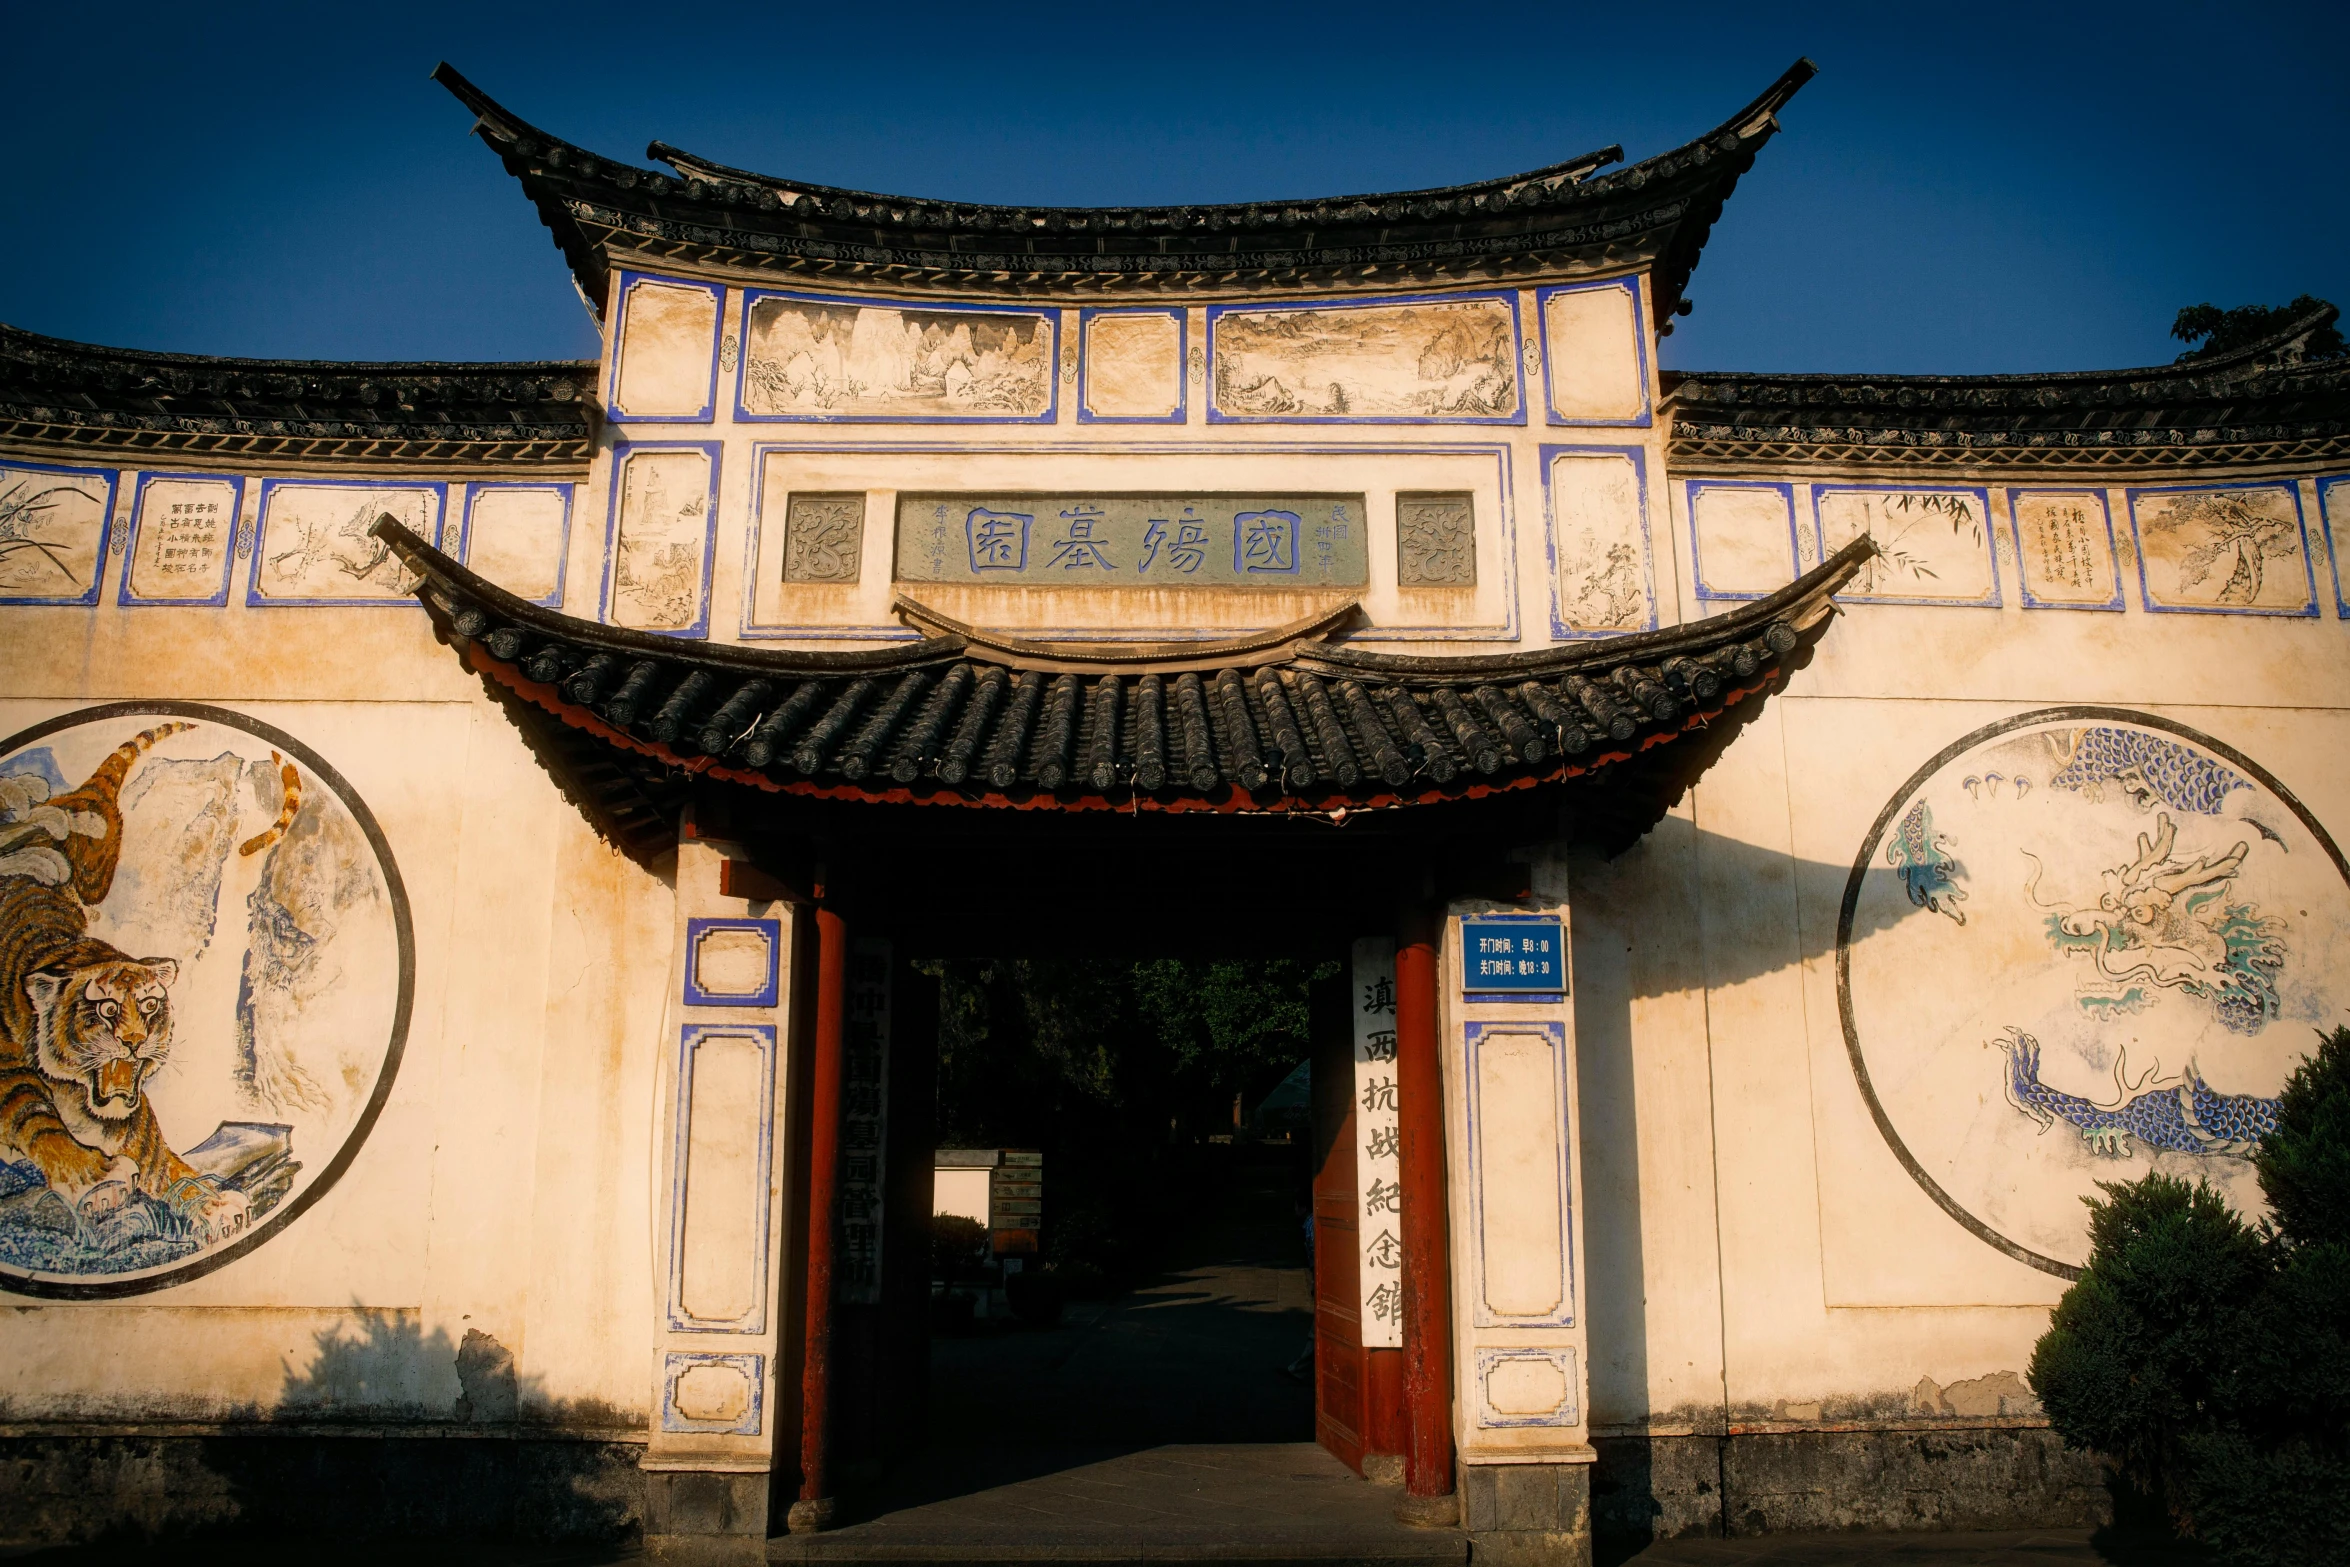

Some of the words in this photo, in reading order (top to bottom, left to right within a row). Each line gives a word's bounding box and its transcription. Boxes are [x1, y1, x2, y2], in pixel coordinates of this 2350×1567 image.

[965, 506, 1302, 576] 國殤墓園
[1331, 505, 1350, 541] 民國
